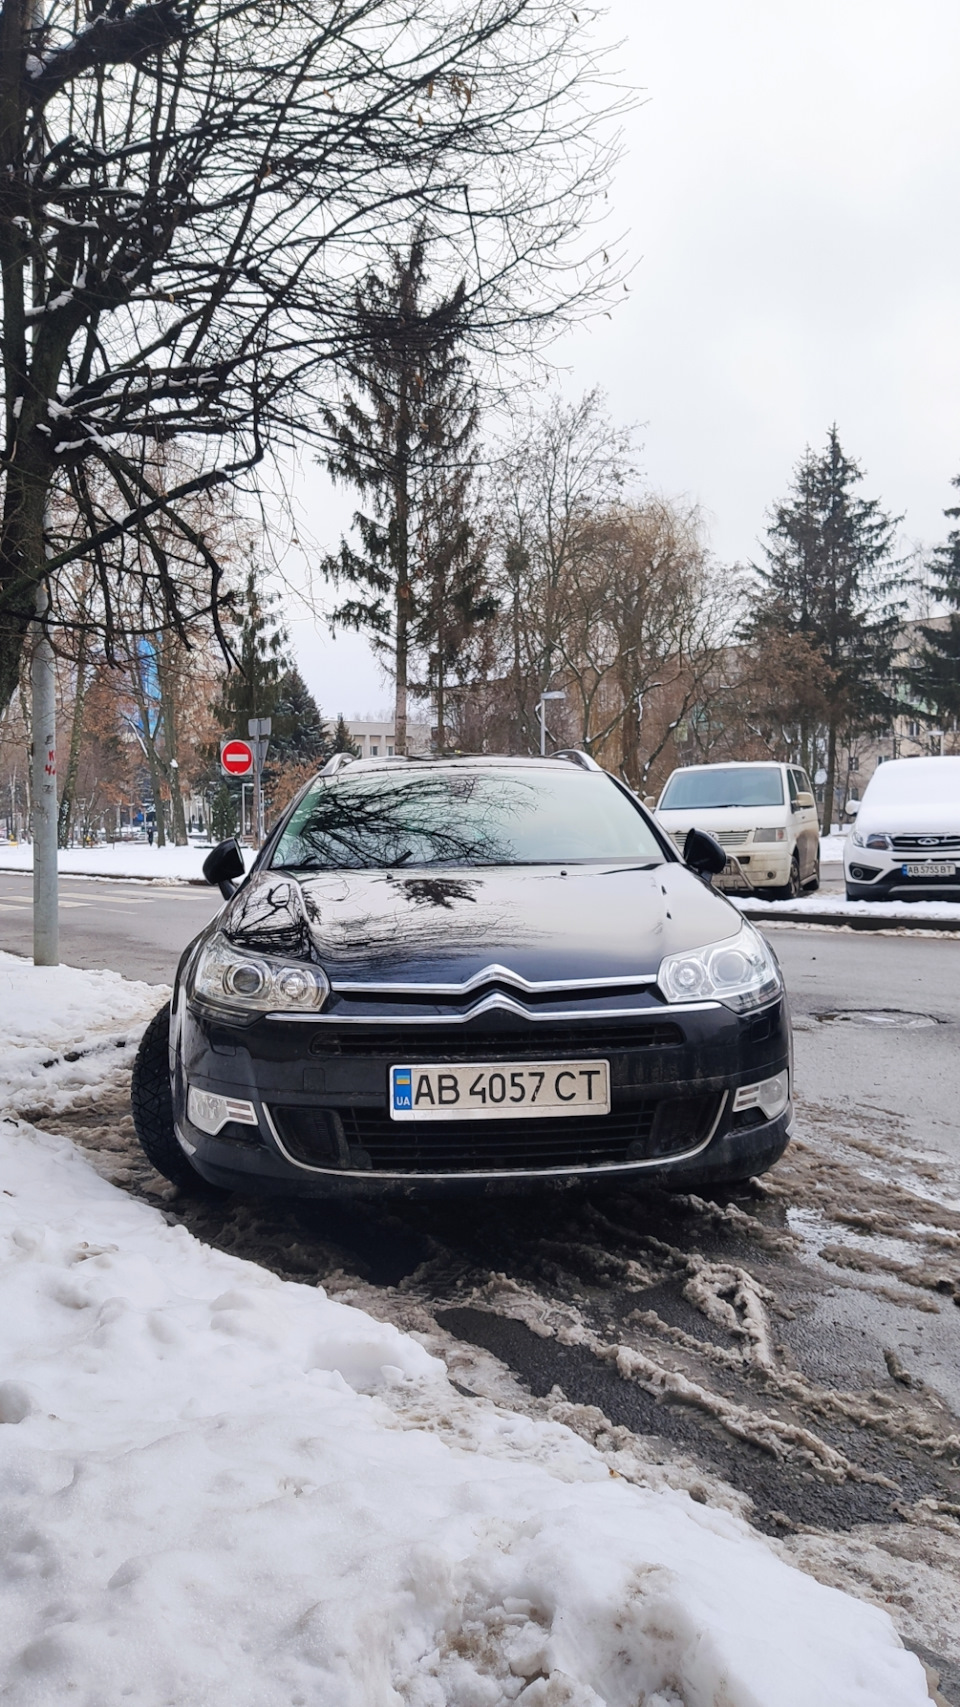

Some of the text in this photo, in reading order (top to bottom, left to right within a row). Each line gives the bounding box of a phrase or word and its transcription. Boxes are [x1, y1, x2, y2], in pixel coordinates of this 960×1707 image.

[908, 866, 919, 874] AB
[920, 866, 939, 874] 5755
[940, 866, 951, 874] BT
[414, 1070, 601, 1105] AB 4057 CT
[396, 1096, 410, 1106] UA
